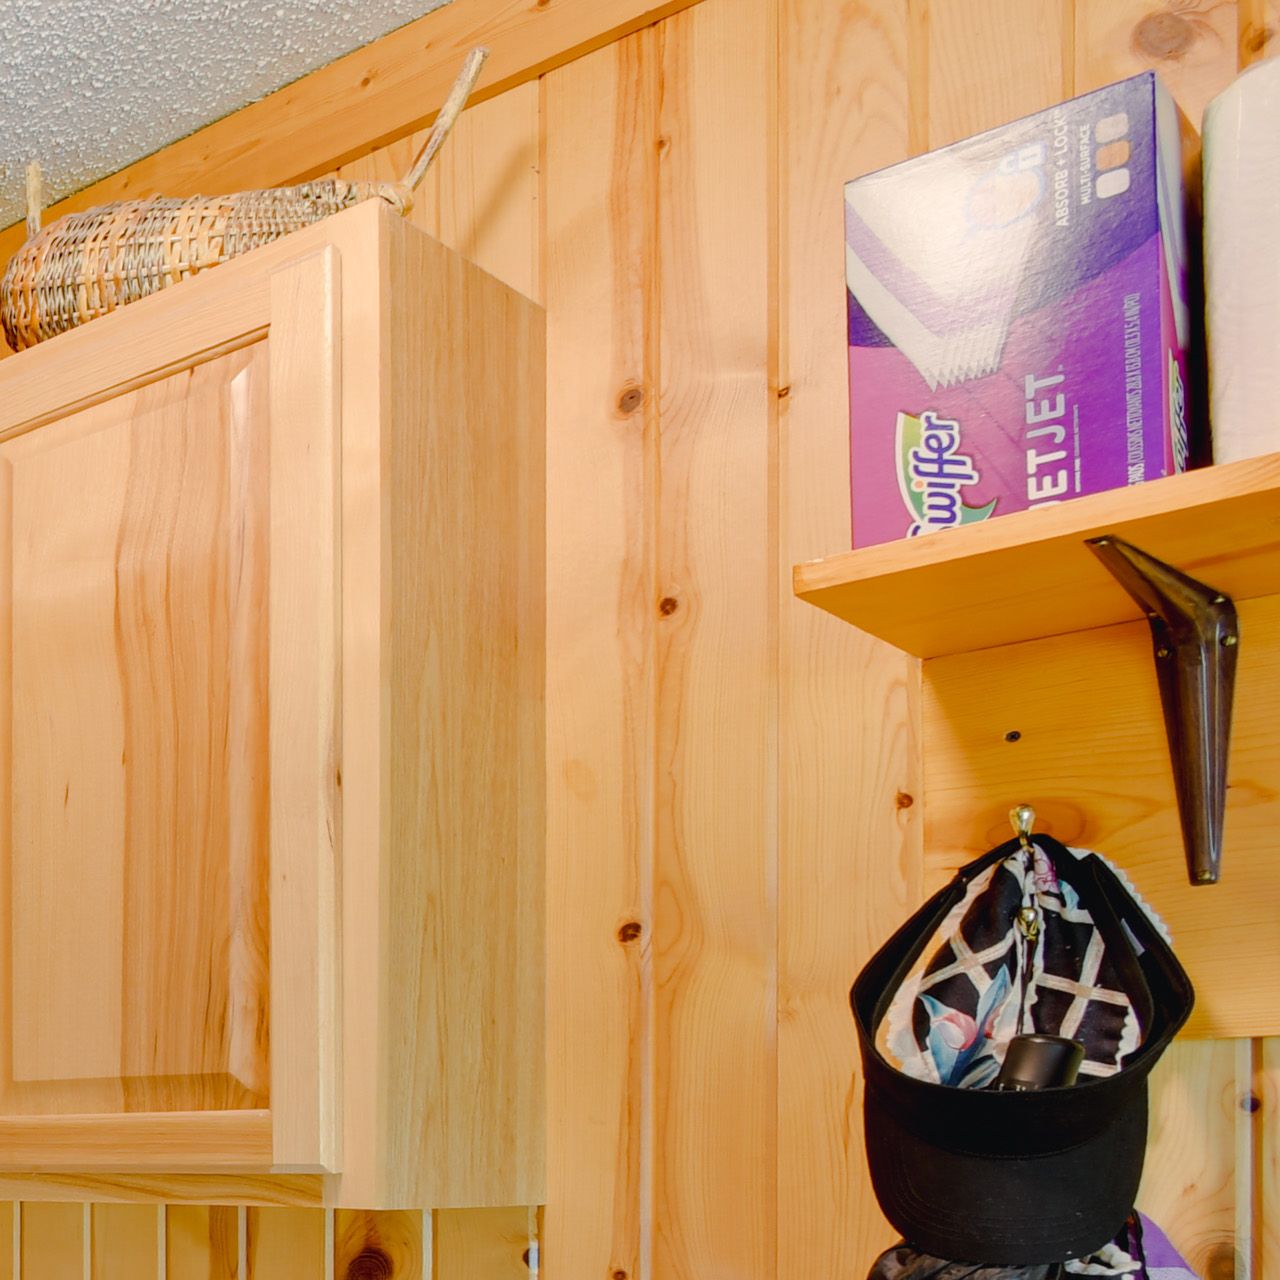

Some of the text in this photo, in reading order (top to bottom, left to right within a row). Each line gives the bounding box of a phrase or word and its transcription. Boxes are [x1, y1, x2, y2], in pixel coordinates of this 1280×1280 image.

[1054, 169, 1069, 226] ABSORB
[1079, 124, 1091, 205] MULTI-SURFACE
[911, 414, 976, 531] wiffer
[1025, 373, 1068, 510] ETJET
